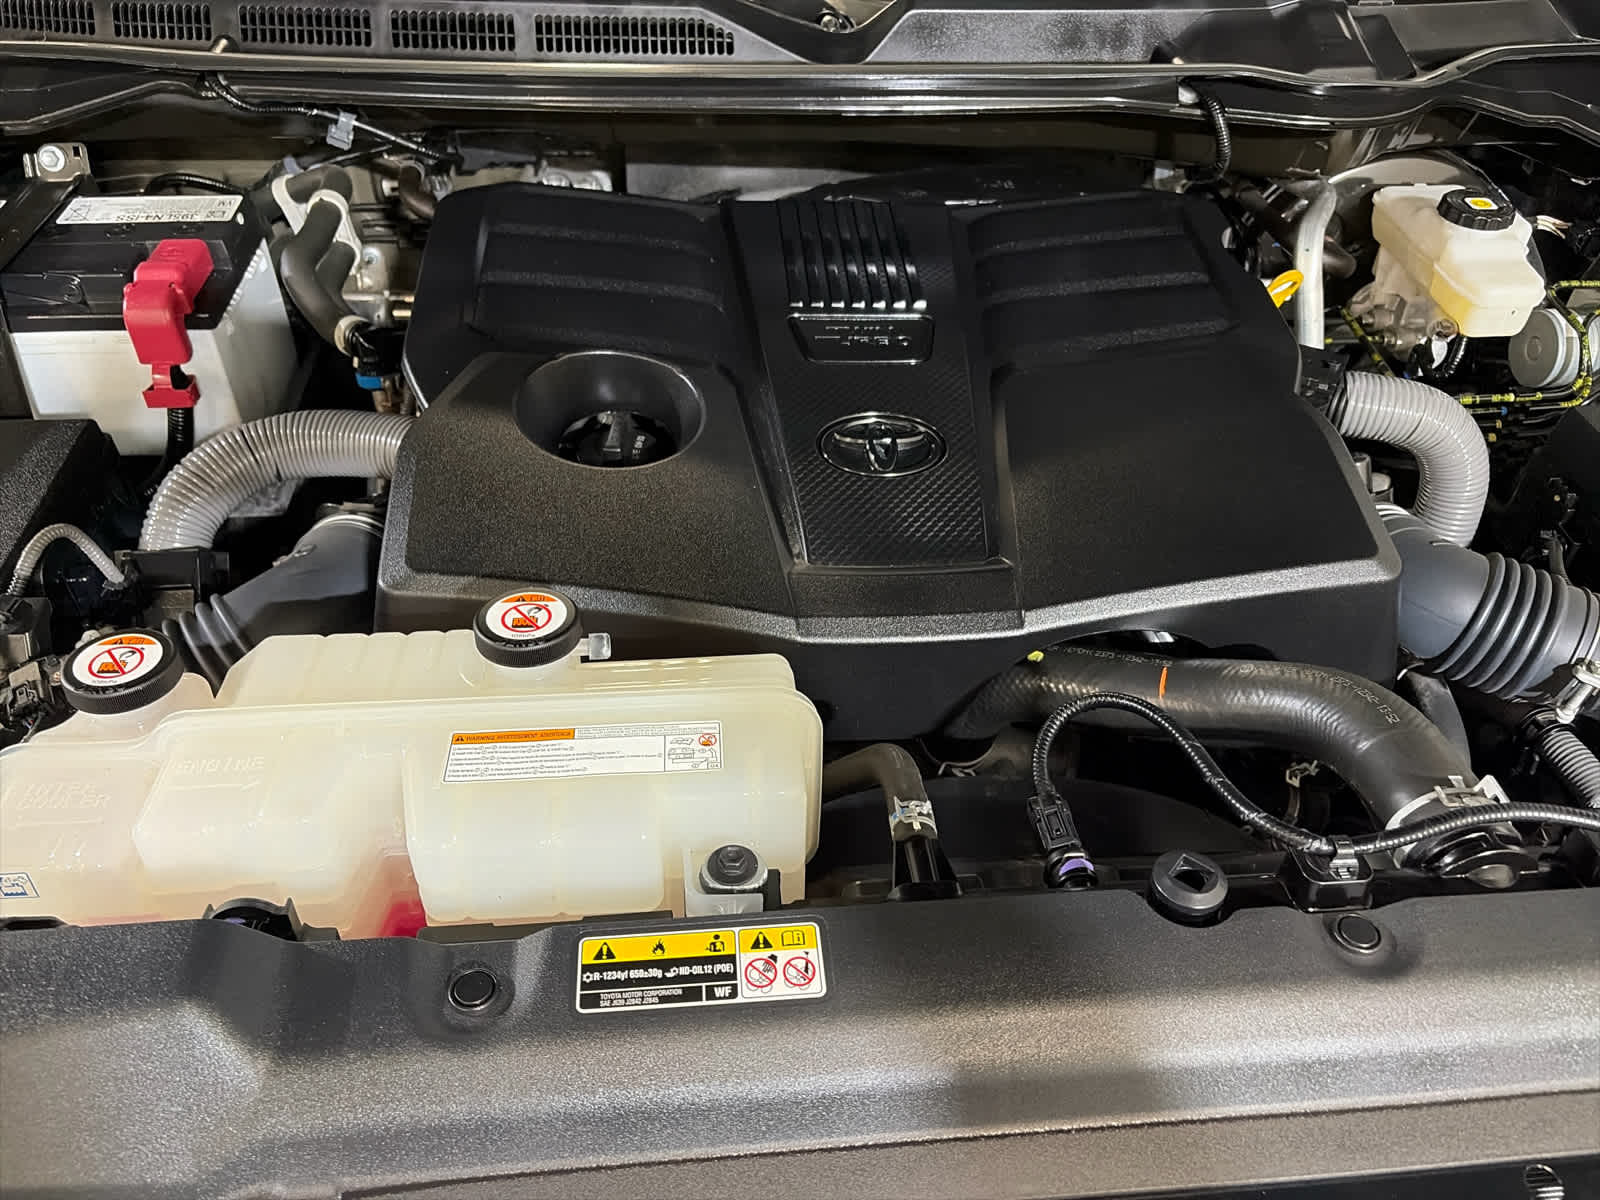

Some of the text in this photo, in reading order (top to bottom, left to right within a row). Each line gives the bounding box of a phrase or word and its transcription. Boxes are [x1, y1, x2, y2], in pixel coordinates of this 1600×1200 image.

[593, 969, 629, 981] R-1234yf
[643, 989, 683, 997] CORPORATION
[714, 986, 732, 997] WF
